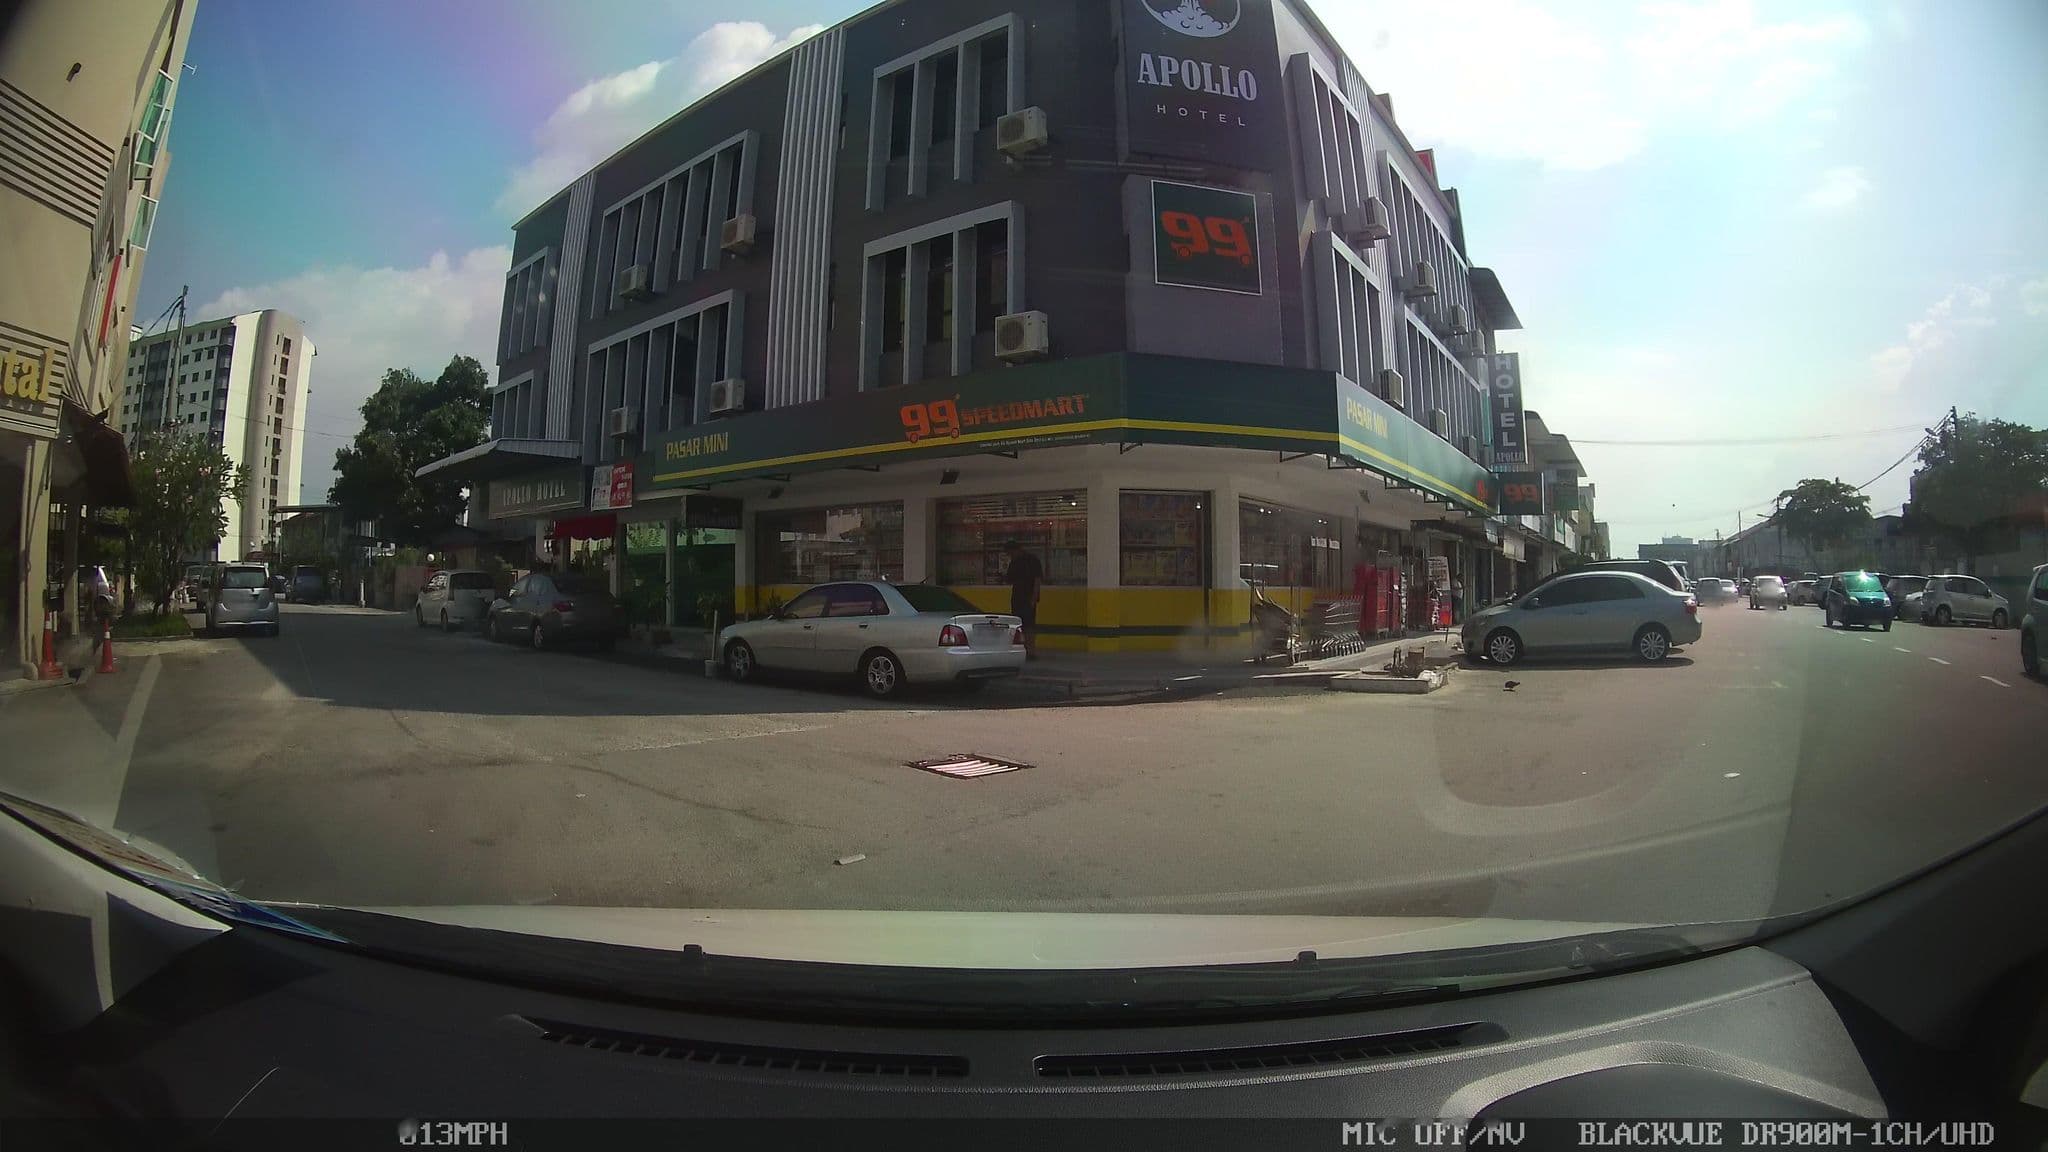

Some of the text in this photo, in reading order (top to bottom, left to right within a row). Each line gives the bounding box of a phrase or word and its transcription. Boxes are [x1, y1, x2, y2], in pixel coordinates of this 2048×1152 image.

[1138, 53, 1257, 101] APOLLO
[1157, 104, 1246, 126] HOTEL
[1162, 210, 1253, 265] 99
[0, 346, 55, 402] tal
[900, 400, 960, 443] 99
[961, 395, 1086, 426] SPEEDMART
[1346, 397, 1372, 431] PASAR
[1495, 356, 1517, 447] HOTEL
[666, 432, 728, 460] PASAR MINI
[1504, 484, 1537, 501] 99
